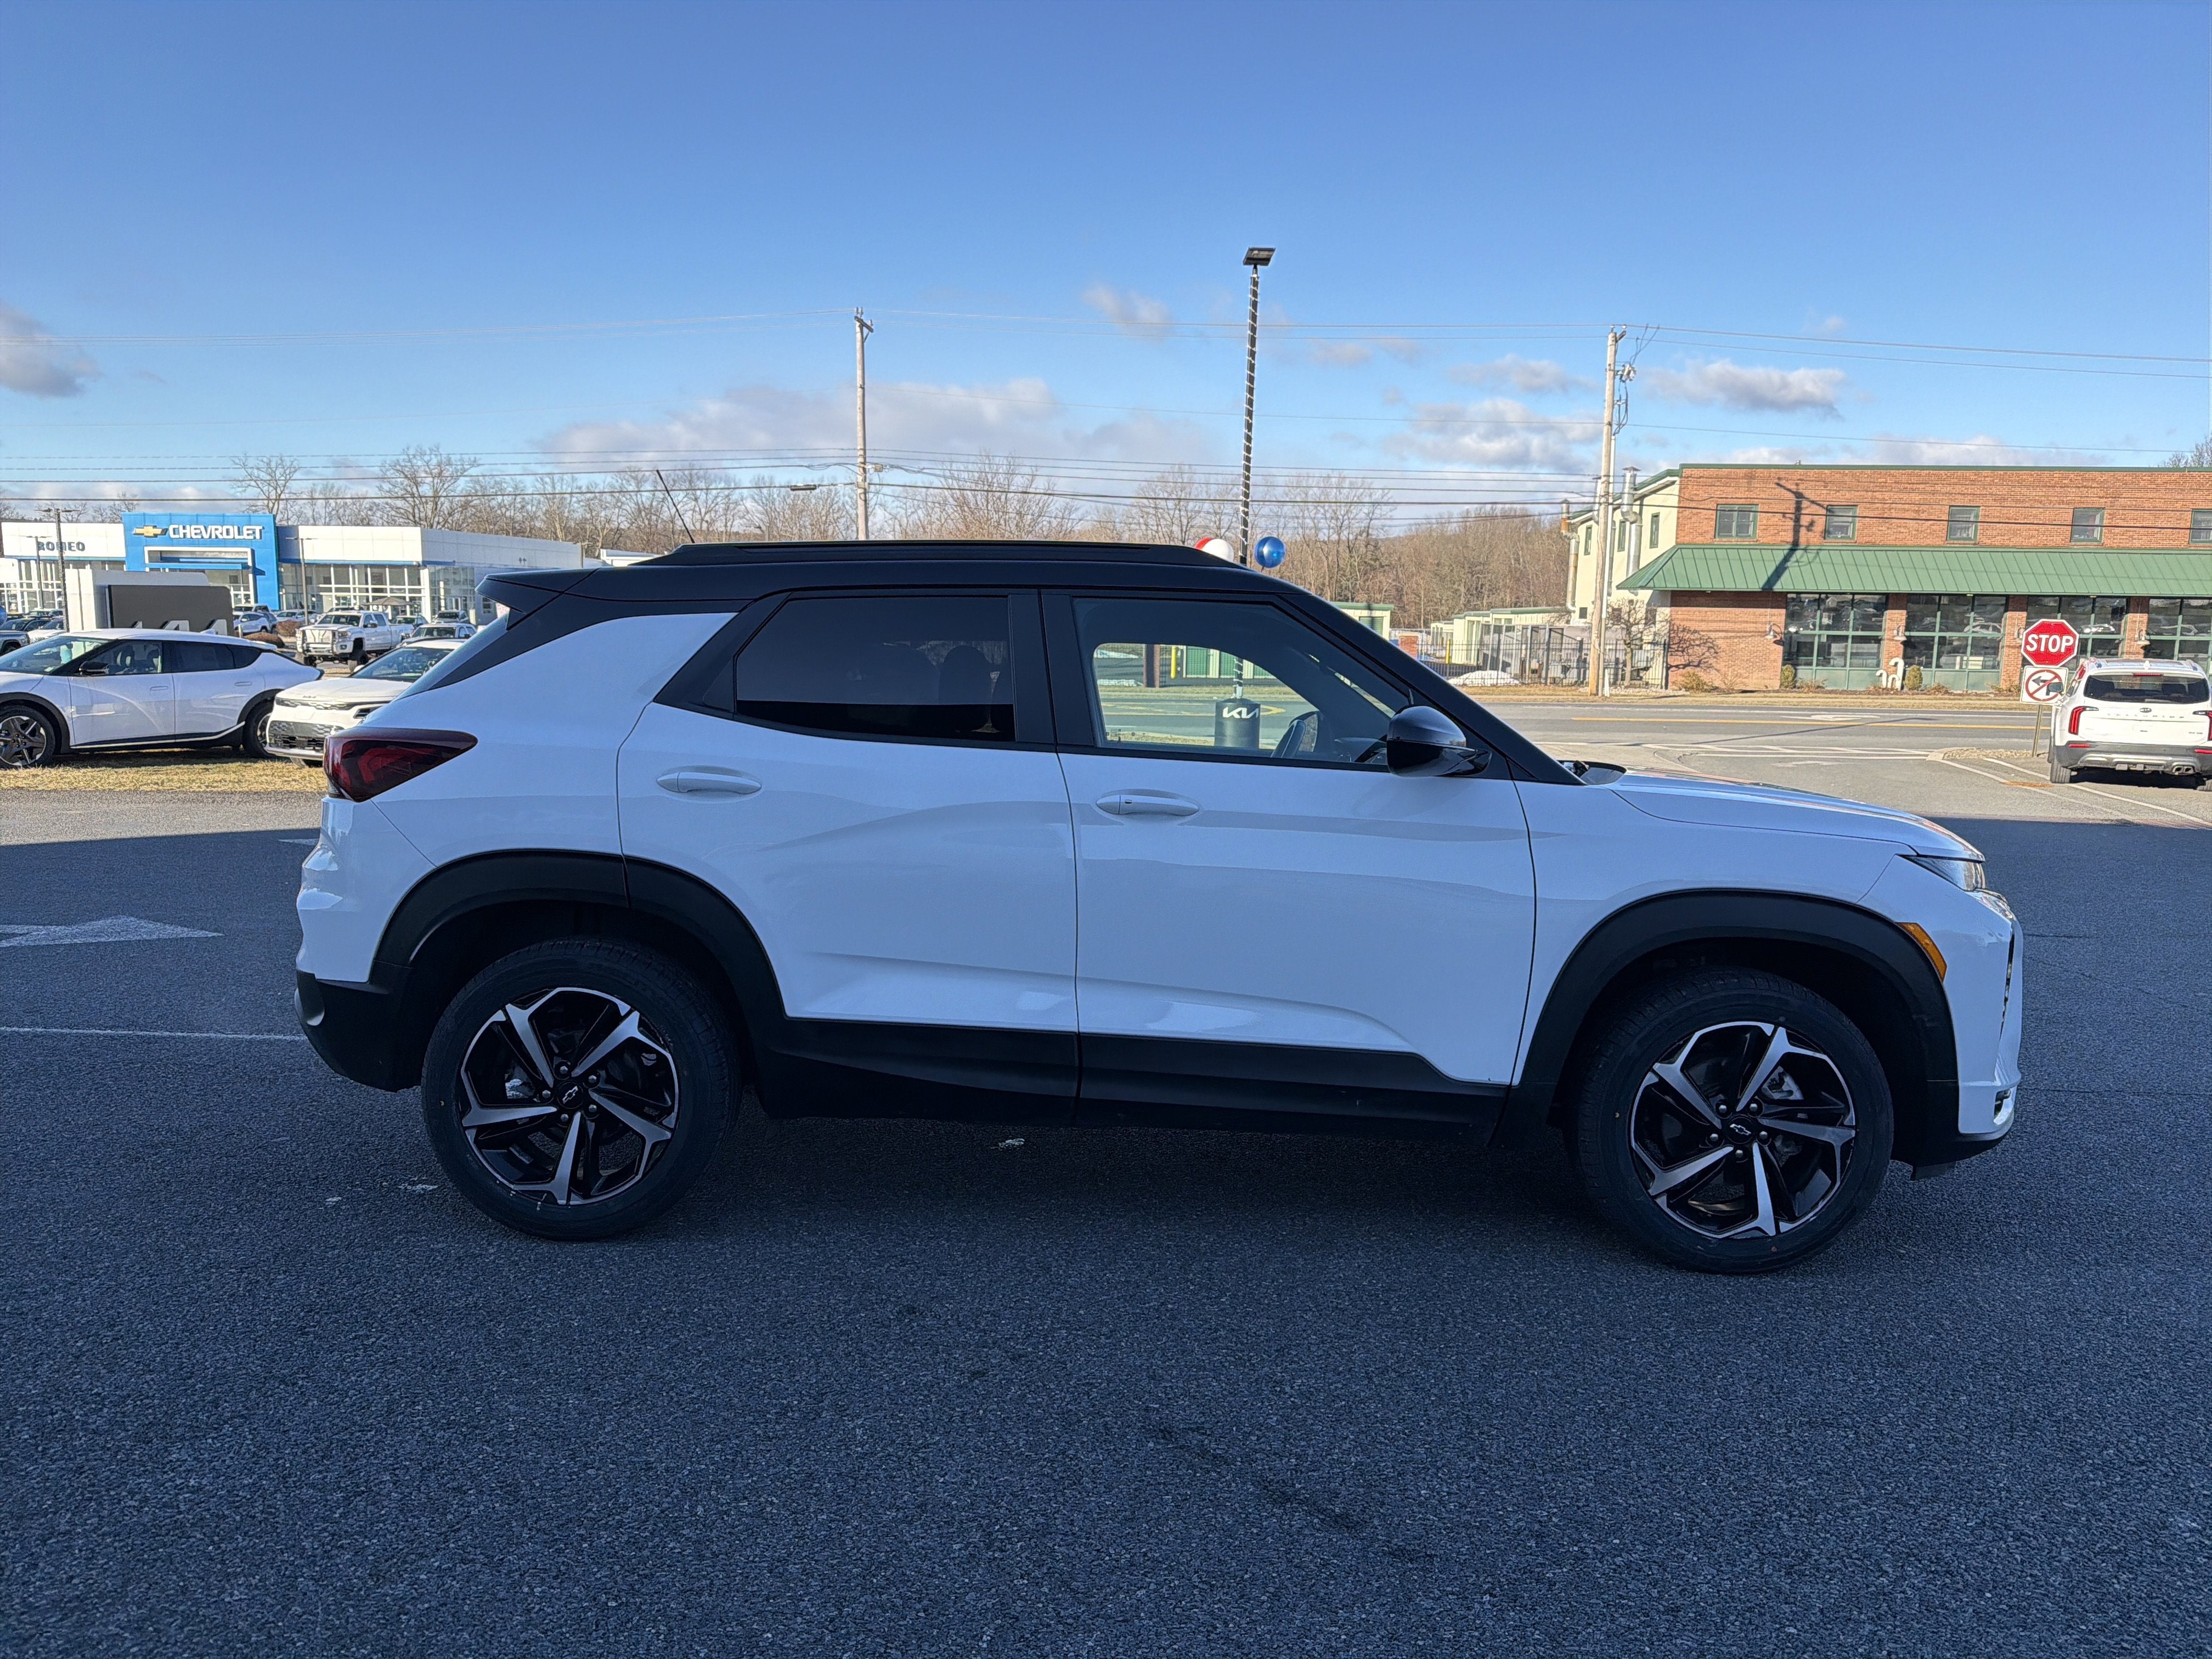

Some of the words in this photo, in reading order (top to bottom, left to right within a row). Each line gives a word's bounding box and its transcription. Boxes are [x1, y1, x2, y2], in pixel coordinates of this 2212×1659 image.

[169, 524, 263, 539] CHEVROLET
[2026, 634, 2074, 653] STOP
[1222, 707, 1259, 718] KIA
